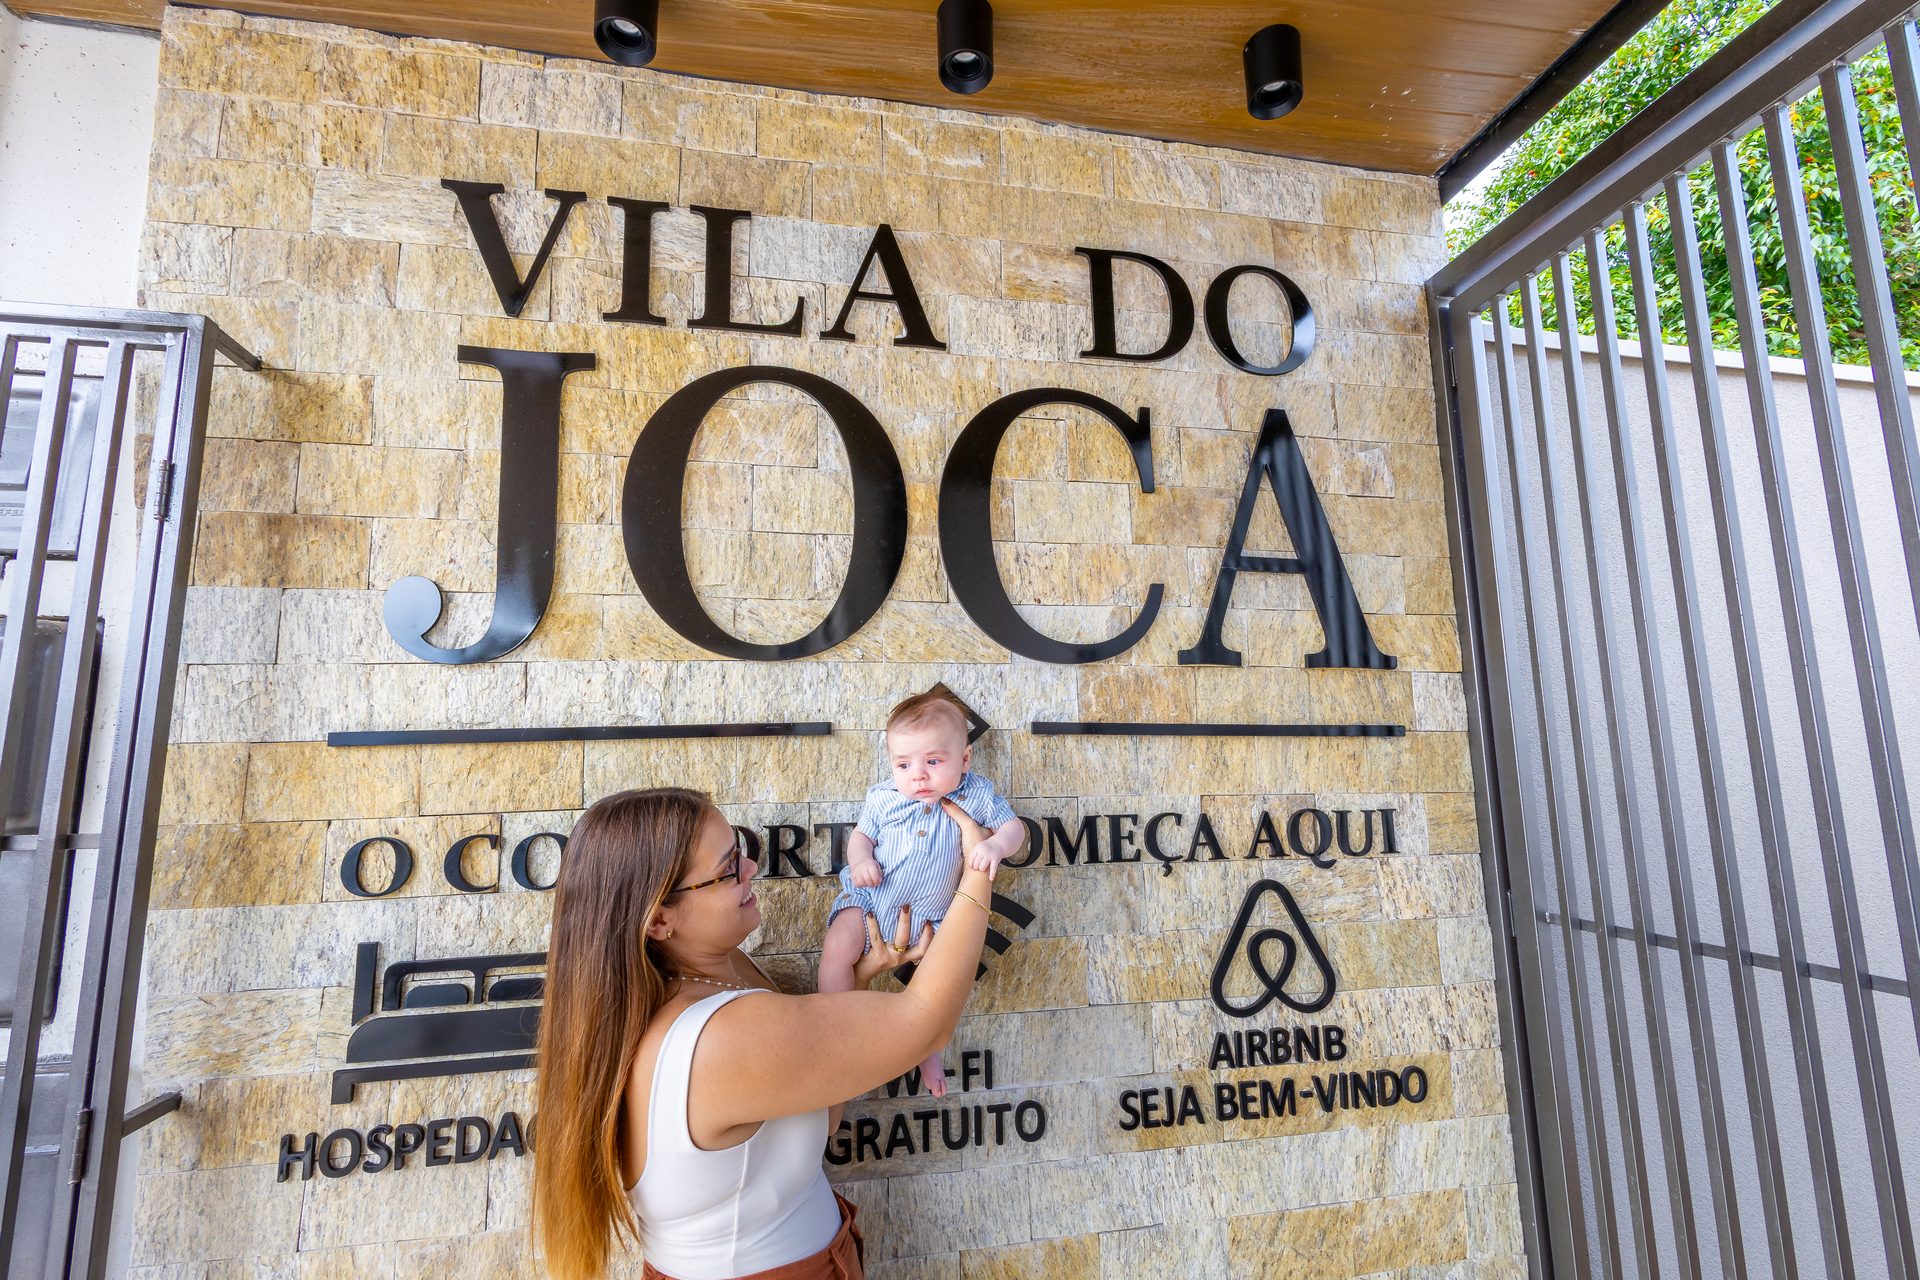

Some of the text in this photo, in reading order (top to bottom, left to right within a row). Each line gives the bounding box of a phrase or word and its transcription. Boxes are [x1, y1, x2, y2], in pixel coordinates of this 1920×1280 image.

[440, 178, 1316, 377] VILA DO
[383, 344, 1398, 670] JOCA
[340, 837, 413, 897] O
[1001, 812, 1229, 877] OMEÇA
[1244, 808, 1400, 869] AQUI
[1208, 1024, 1347, 1070] AIRBNB
[824, 1100, 1046, 1166] GRATUITO
[1119, 1065, 1429, 1131] SEJA BEM-VINDO
[276, 1111, 539, 1183] HOSPEDA
